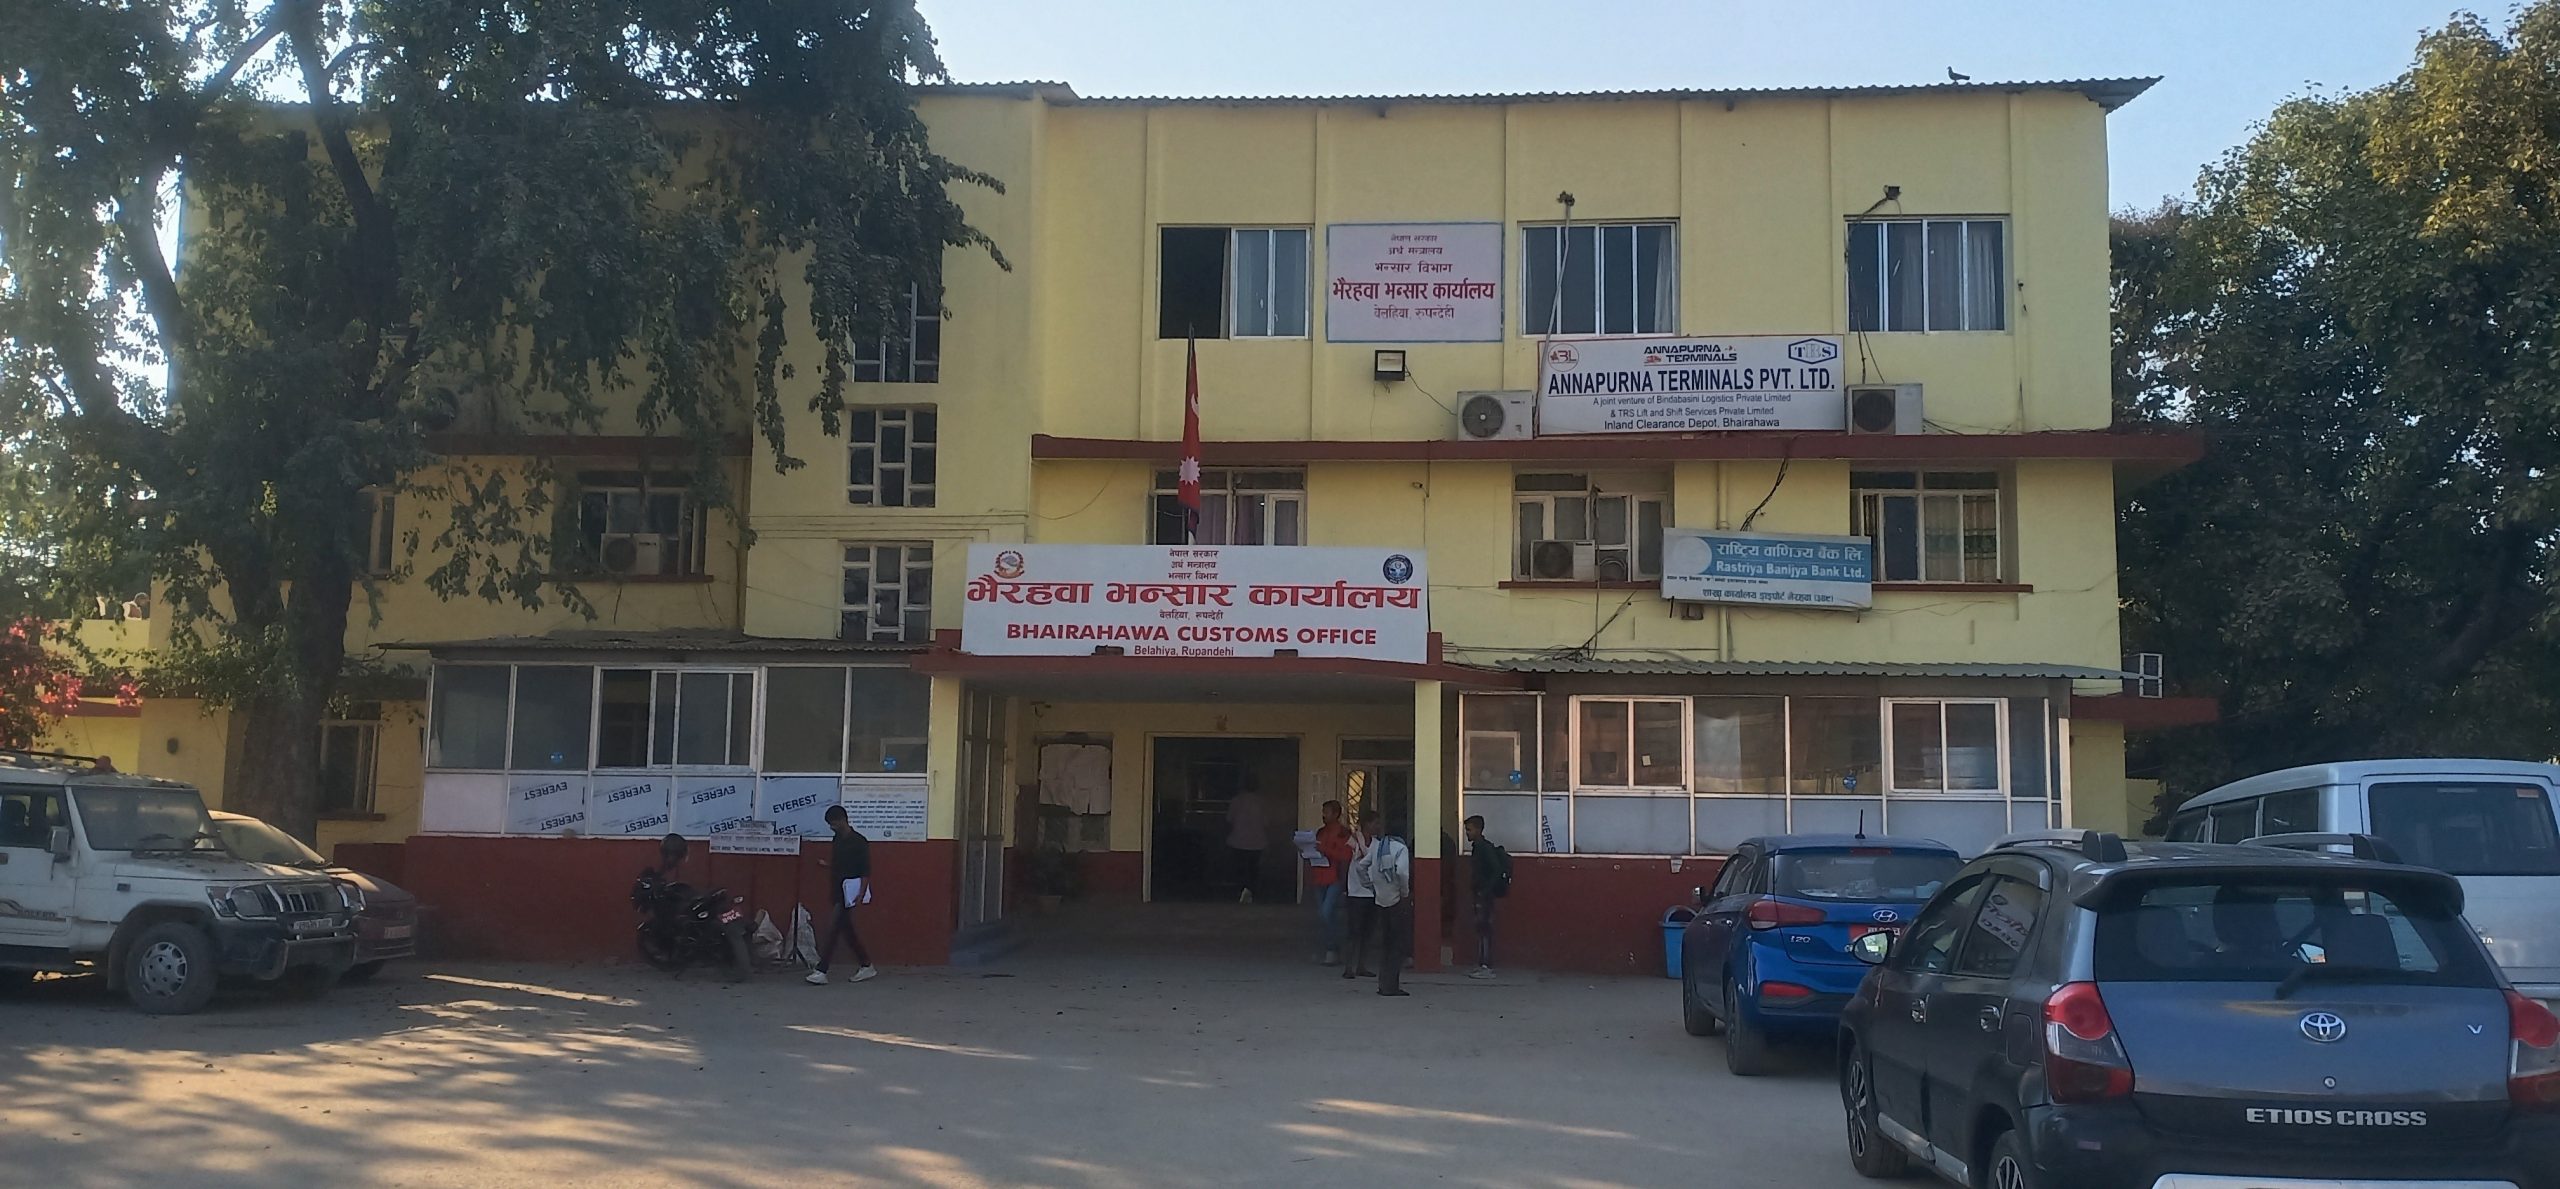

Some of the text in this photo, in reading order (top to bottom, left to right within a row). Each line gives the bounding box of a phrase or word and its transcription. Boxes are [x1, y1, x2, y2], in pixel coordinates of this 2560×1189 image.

[1375, 260, 1453, 273] भन्सार विभाग
[1333, 277, 1496, 301] भैरहवा भन्सार कार्यालय
[1644, 344, 1721, 354] ANNAPURNA
[1666, 353, 1738, 363] TERMINALS
[1548, 367, 1835, 394] ANNAPURNA TERMINALS PVT. LTD.
[1600, 397, 1616, 407] joint
[1617, 396, 1646, 405] venture
[1647, 395, 1655, 404] of
[1656, 394, 1699, 404] Bindabasini
[1701, 394, 1734, 405] Logistics
[1736, 393, 1763, 402] Private
[1764, 393, 1792, 402] Limited
[1610, 406, 1774, 418] & TRS Lift and Shift Services Private Limited
[1604, 420, 1634, 430] Inland
[1636, 419, 1685, 429] Clearance
[1722, 417, 1780, 427] Bhairahawa
[1169, 548, 1219, 559] नेपाल सरकार
[1763, 543, 1814, 559] वाणिज्य
[1171, 560, 1184, 569] अर्थ
[1716, 561, 1865, 579] Rastriya Banijya Bank Ltd.
[1168, 570, 1219, 580] भन्सार विभाग
[967, 574, 1422, 610] भैरहवा भन्सार कार्यालय
[1006, 623, 1377, 645] BHAIRAHAWA CUSTOMS OFFICE
[1134, 645, 1234, 657] Belahiya, Rupandehi
[524, 781, 568, 801] EVEREST
[607, 783, 652, 803] EVEREST
[692, 784, 736, 804] EVEREST
[773, 794, 817, 814] EVEREST
[541, 811, 585, 831] EVEREST
[624, 813, 669, 833] EVEREST
[2466, 1023, 2483, 1035] V
[2246, 1107, 2427, 1127] ETIOS CROSS
